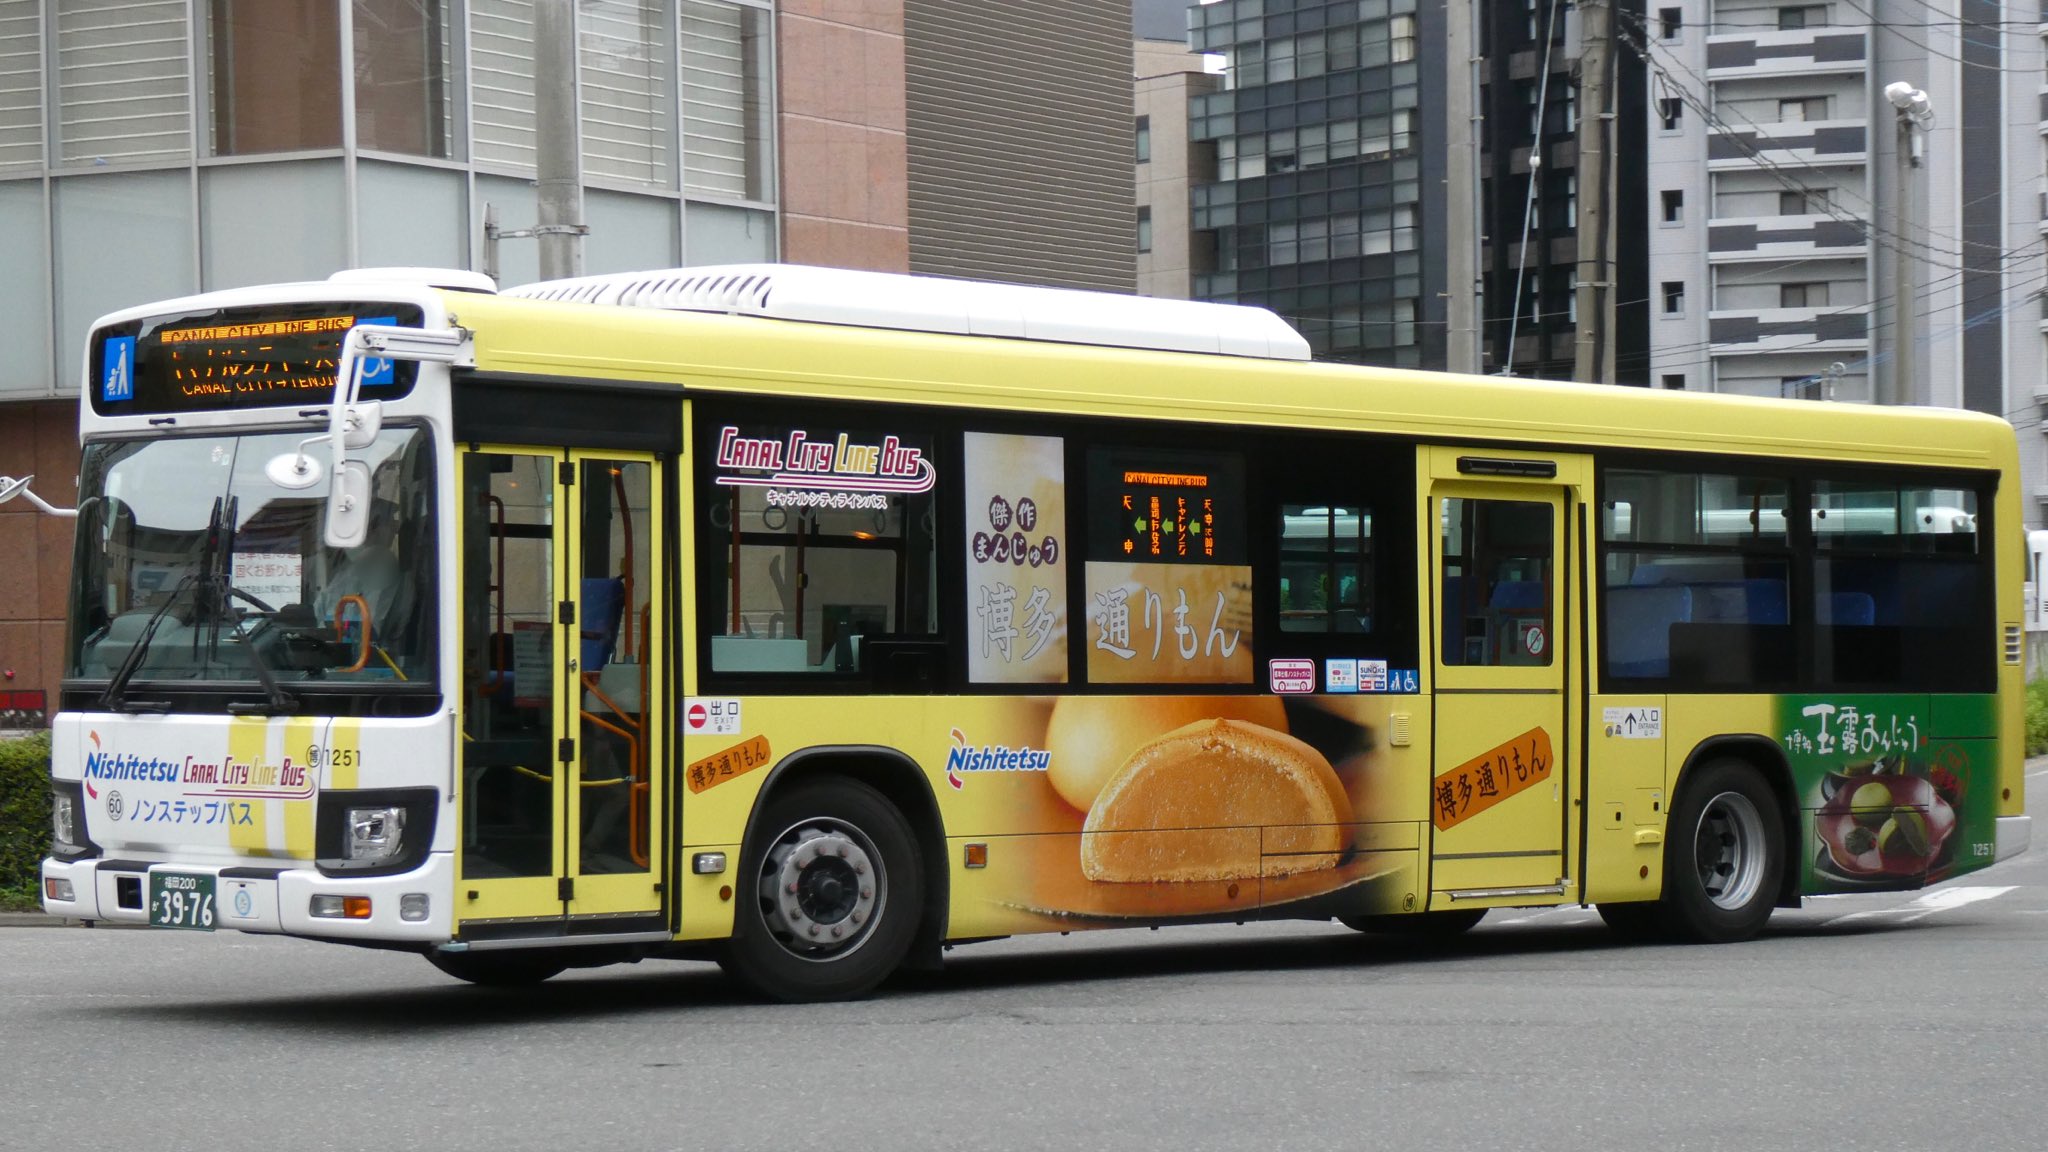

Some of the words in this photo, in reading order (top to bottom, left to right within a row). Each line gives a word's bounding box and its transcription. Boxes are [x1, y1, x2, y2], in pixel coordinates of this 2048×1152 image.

[316, 318, 346, 332] BUS
[717, 426, 783, 470] CANAL
[786, 430, 834, 472] CITY
[834, 432, 880, 474] LINE
[880, 436, 921, 476] BUS
[990, 499, 1035, 529] 傑作
[974, 534, 1057, 566] まんじゅう
[711, 700, 738, 716] 出口
[715, 716, 734, 724] EXIT
[1639, 708, 1659, 722] 入口
[84, 751, 179, 783] Nishitetsu
[183, 756, 218, 784] CANAL
[222, 756, 248, 785] CITY
[251, 757, 277, 786] LINE
[280, 759, 305, 787] BUS
[325, 749, 361, 768] 1251
[692, 742, 766, 789] 博多通りもん
[945, 745, 1051, 773] Nishitetsu
[1436, 739, 1546, 822] 博多通りもん
[108, 797, 122, 814] 60
[130, 800, 253, 825] ノンステップバス
[1972, 844, 1995, 856] 1251
